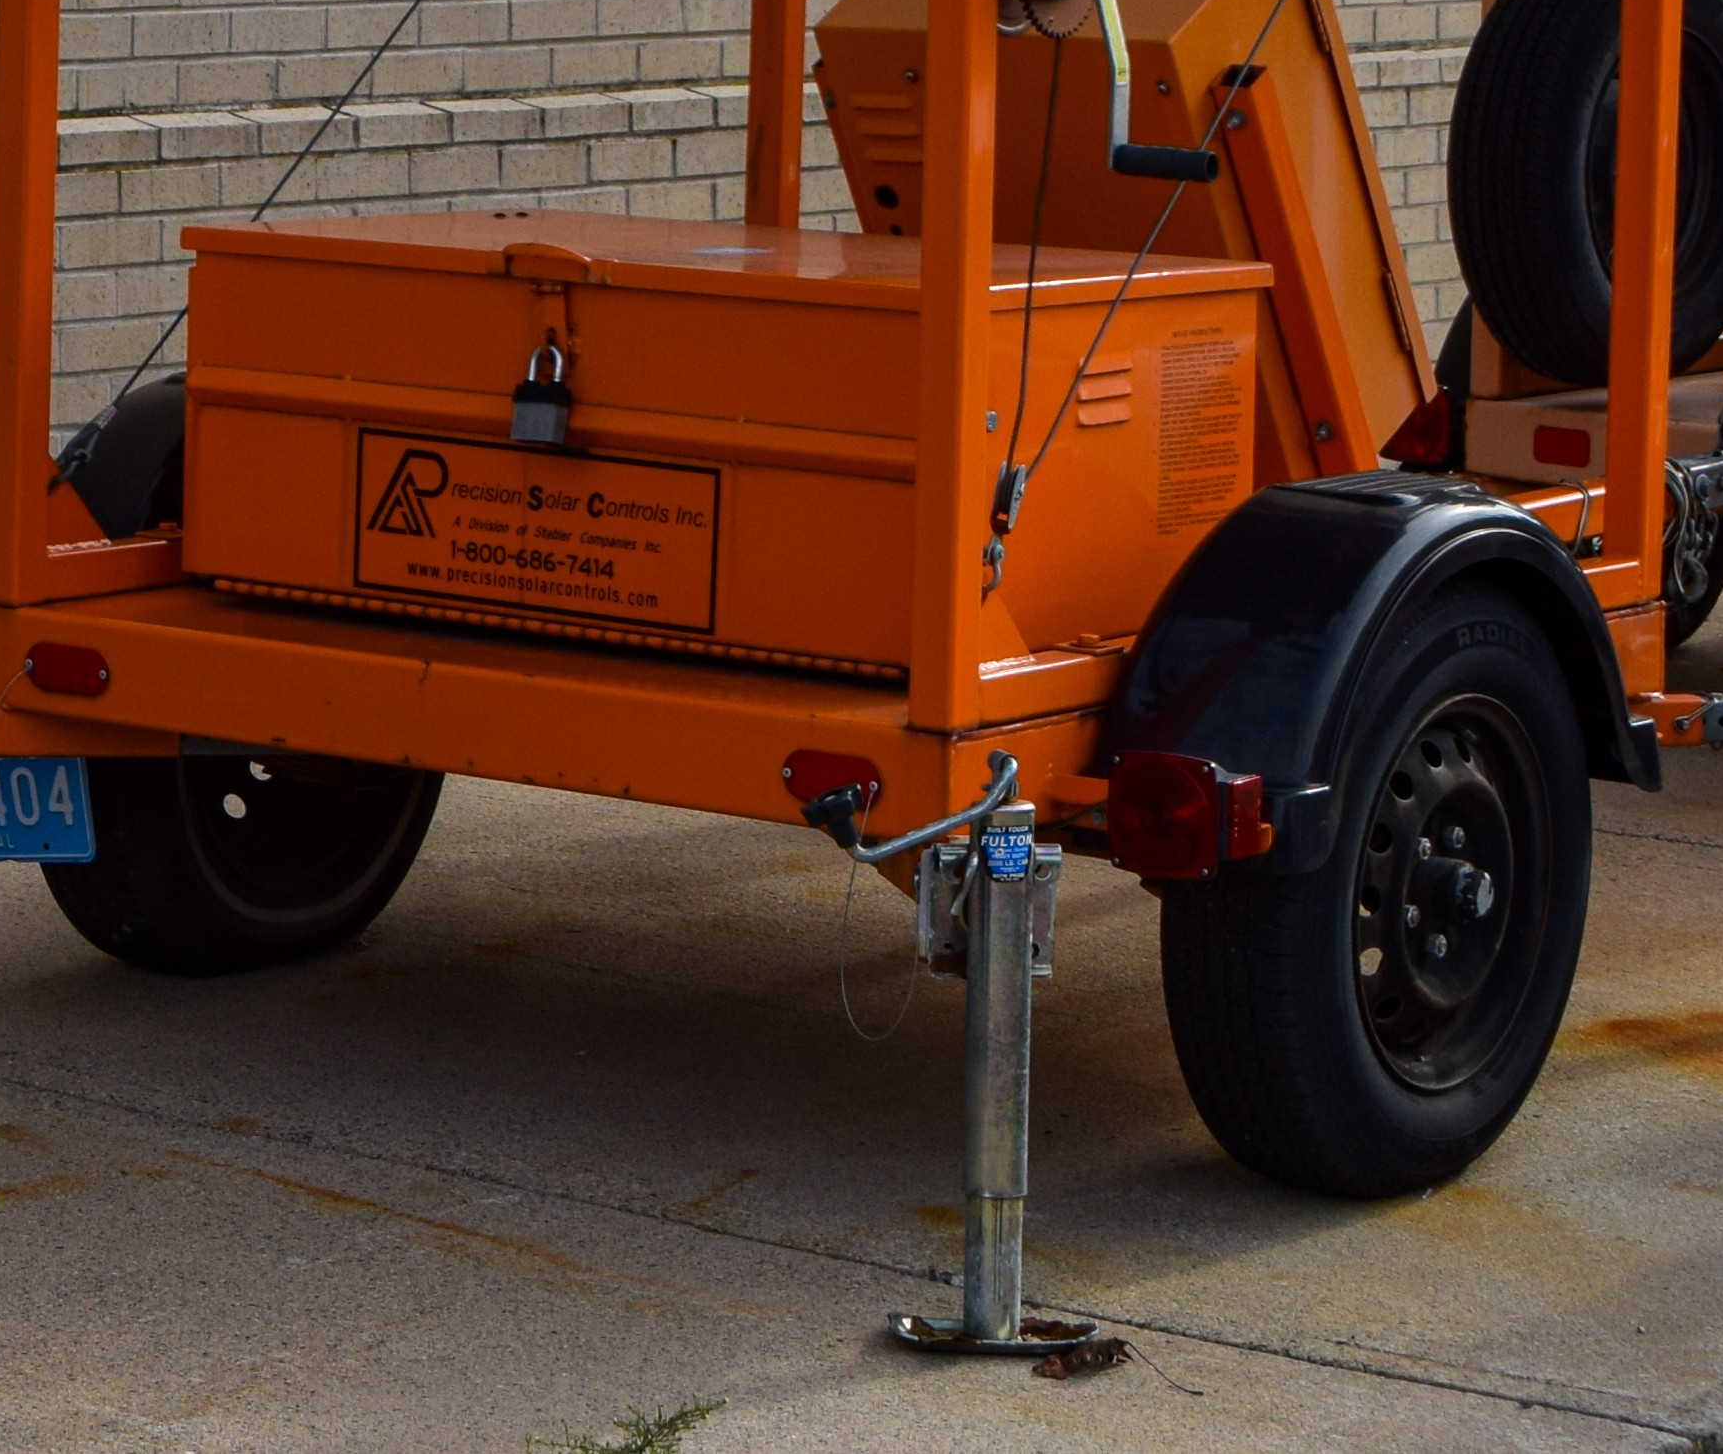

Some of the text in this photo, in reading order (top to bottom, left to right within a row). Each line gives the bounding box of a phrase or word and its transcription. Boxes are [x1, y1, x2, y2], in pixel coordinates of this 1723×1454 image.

[527, 485, 581, 512] Solar
[587, 492, 669, 523] Controls
[675, 505, 708, 529] Inc.
[452, 516, 461, 527] A
[468, 518, 510, 533] Division
[516, 524, 528, 536] of
[580, 532, 637, 550] Companies
[451, 539, 615, 580] 1-800-686-7414
[407, 562, 659, 609] www.precisionsolarcontrols.com
